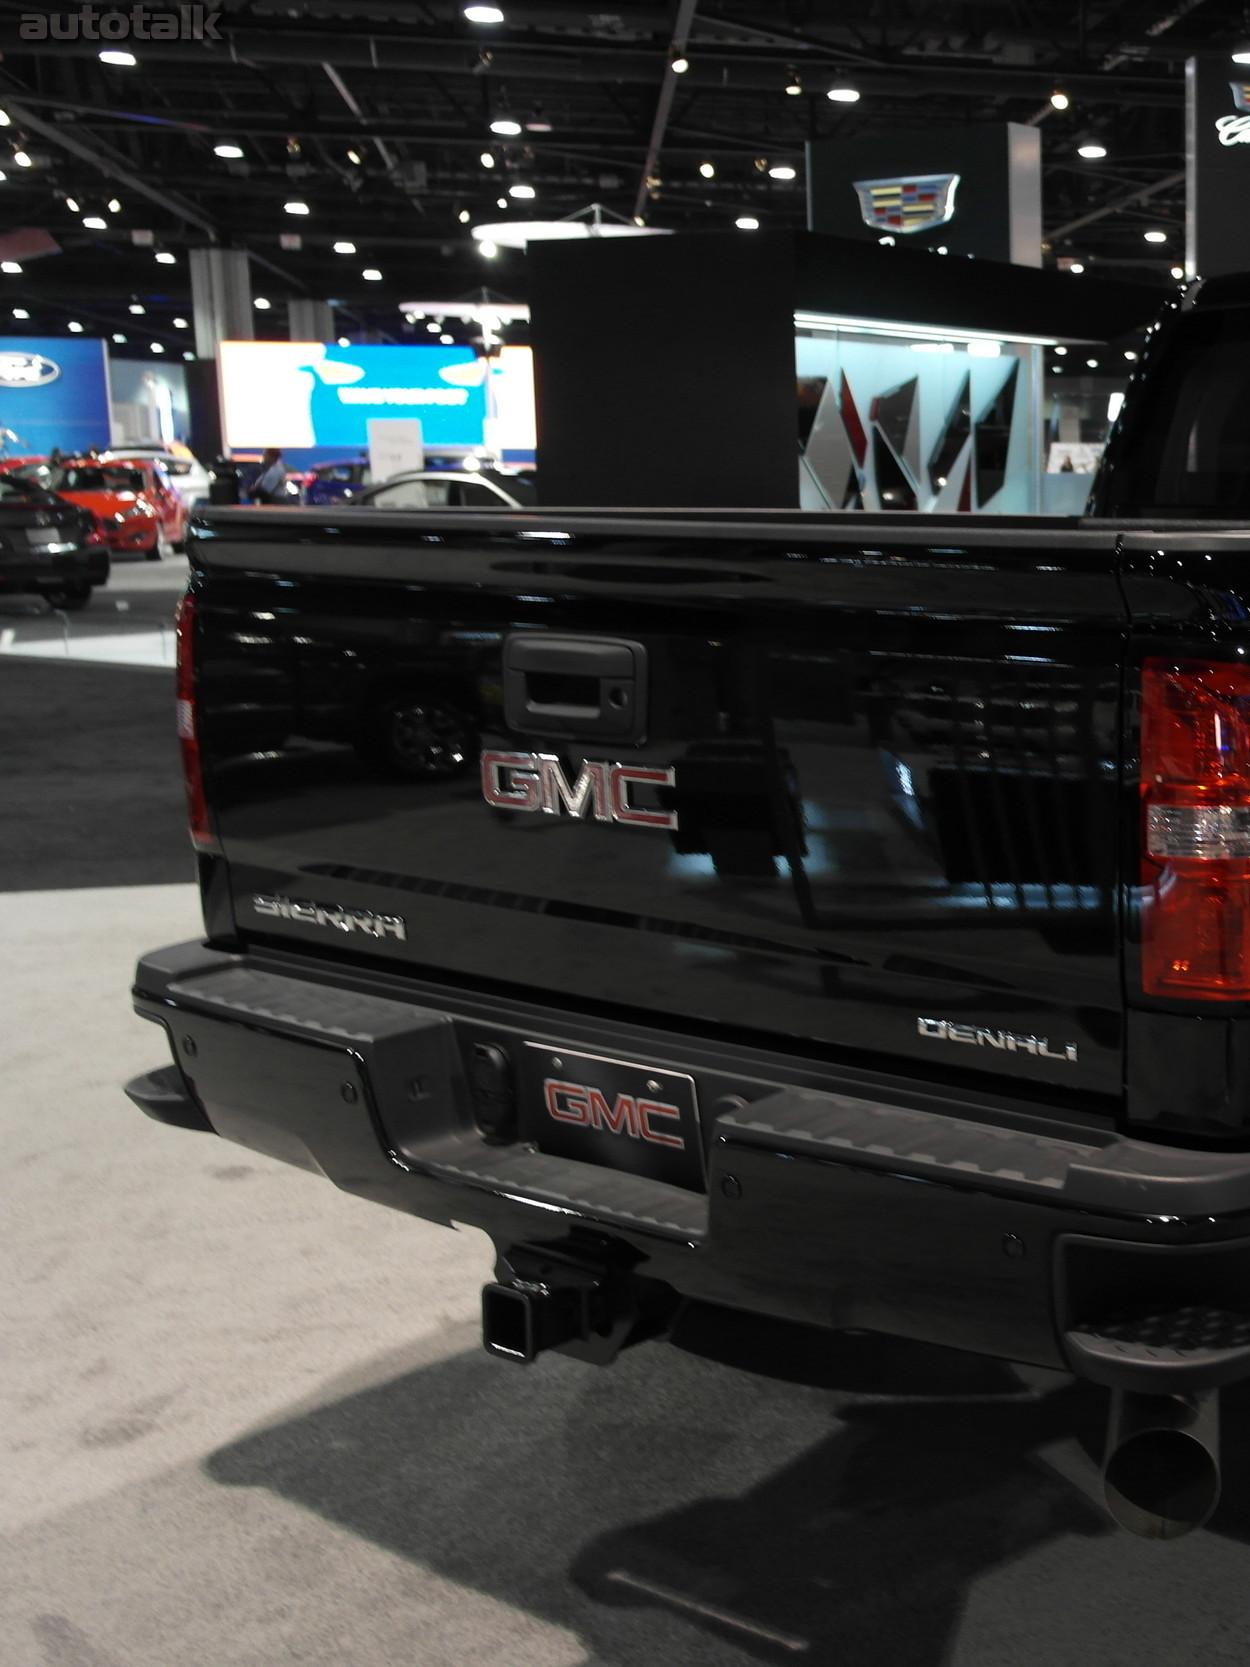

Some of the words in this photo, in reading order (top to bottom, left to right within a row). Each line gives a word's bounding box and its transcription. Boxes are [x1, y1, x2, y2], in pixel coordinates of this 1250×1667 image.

[479, 750, 679, 831] GMC
[251, 893, 407, 941] SIERRA
[917, 1017, 1078, 1062] DENALI
[543, 1078, 685, 1150] GMC
